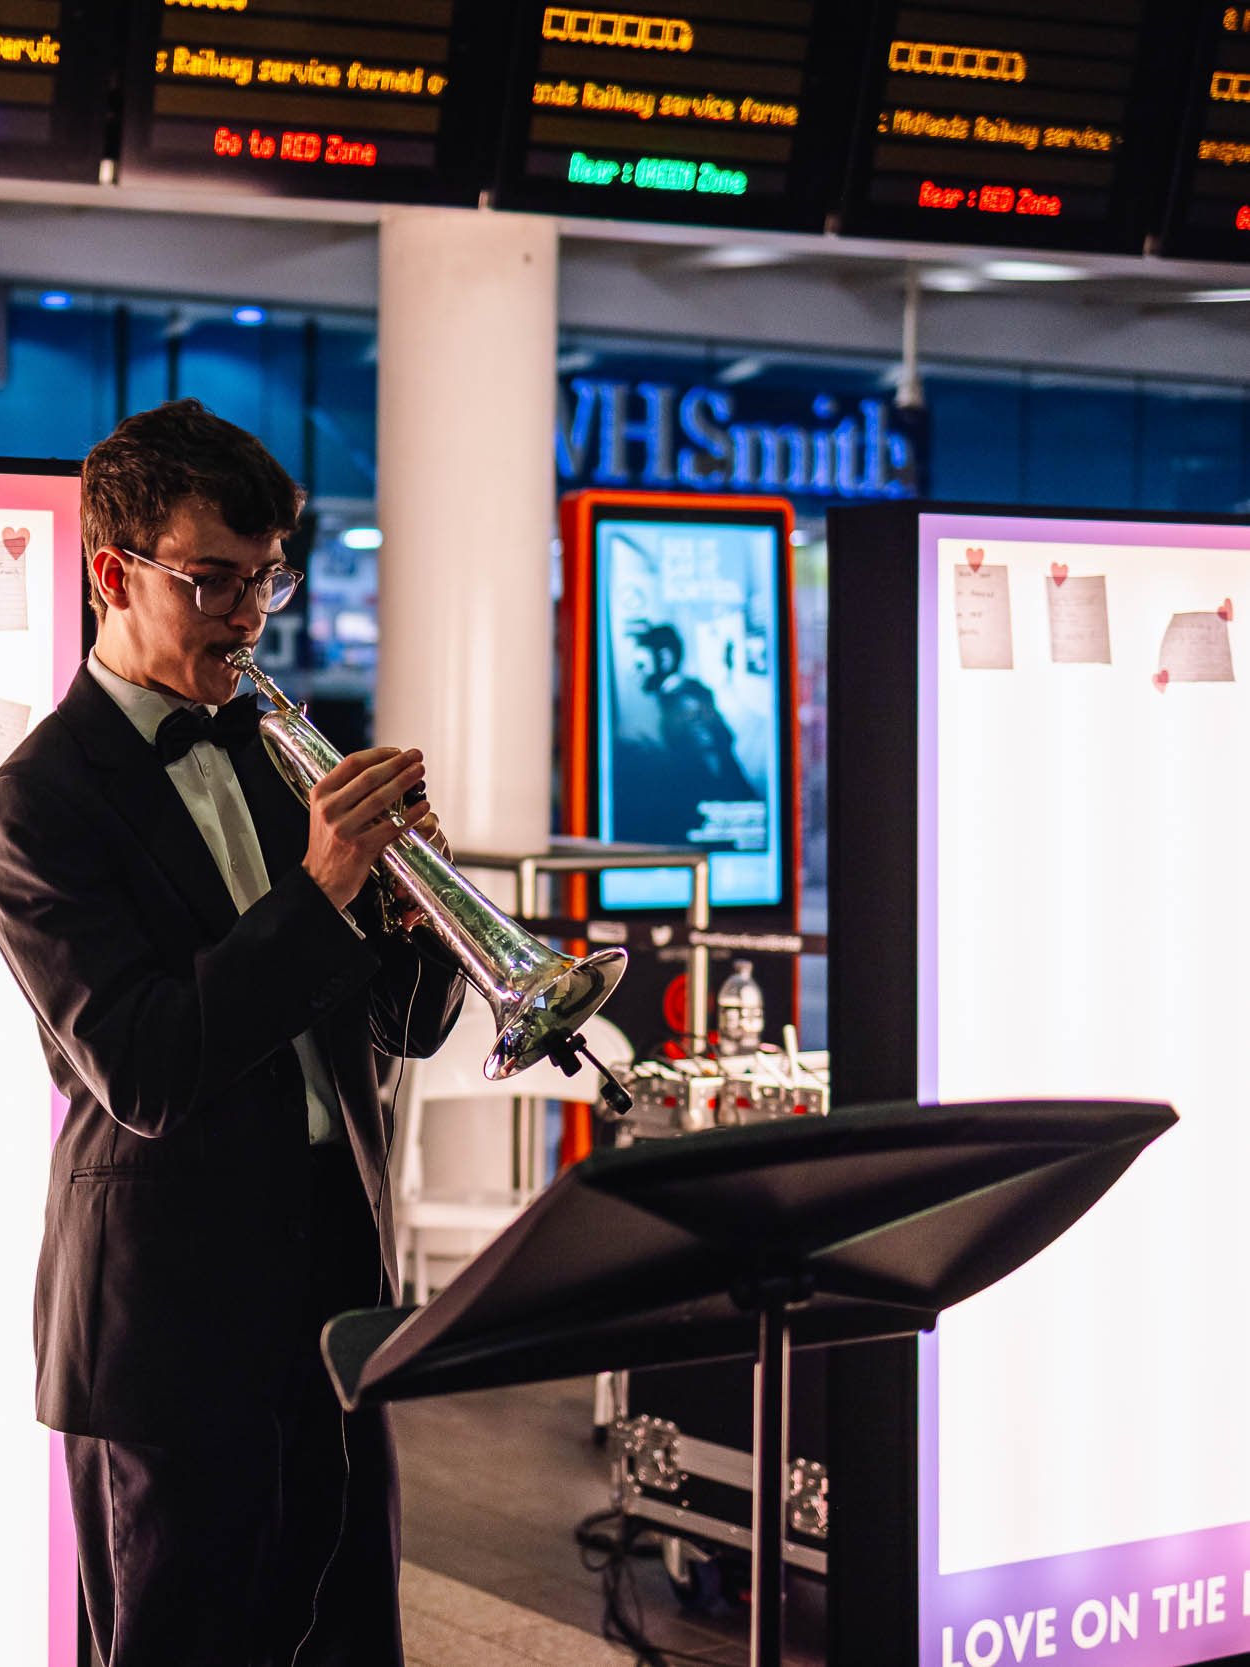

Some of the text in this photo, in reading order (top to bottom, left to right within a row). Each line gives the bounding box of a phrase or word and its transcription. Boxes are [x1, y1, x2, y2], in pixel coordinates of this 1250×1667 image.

[172, 45, 254, 86] Railway
[258, 58, 342, 88] service
[581, 82, 656, 121] Railway
[658, 92, 736, 121] service
[213, 126, 378, 167] Go to RED Zone
[696, 162, 748, 195] Zone
[978, 185, 1015, 213] RED
[1016, 187, 1062, 217] Zone
[941, 1607, 1057, 1667] LOVE
[1071, 1591, 1139, 1649] ON
[1151, 1575, 1227, 1634] THE
